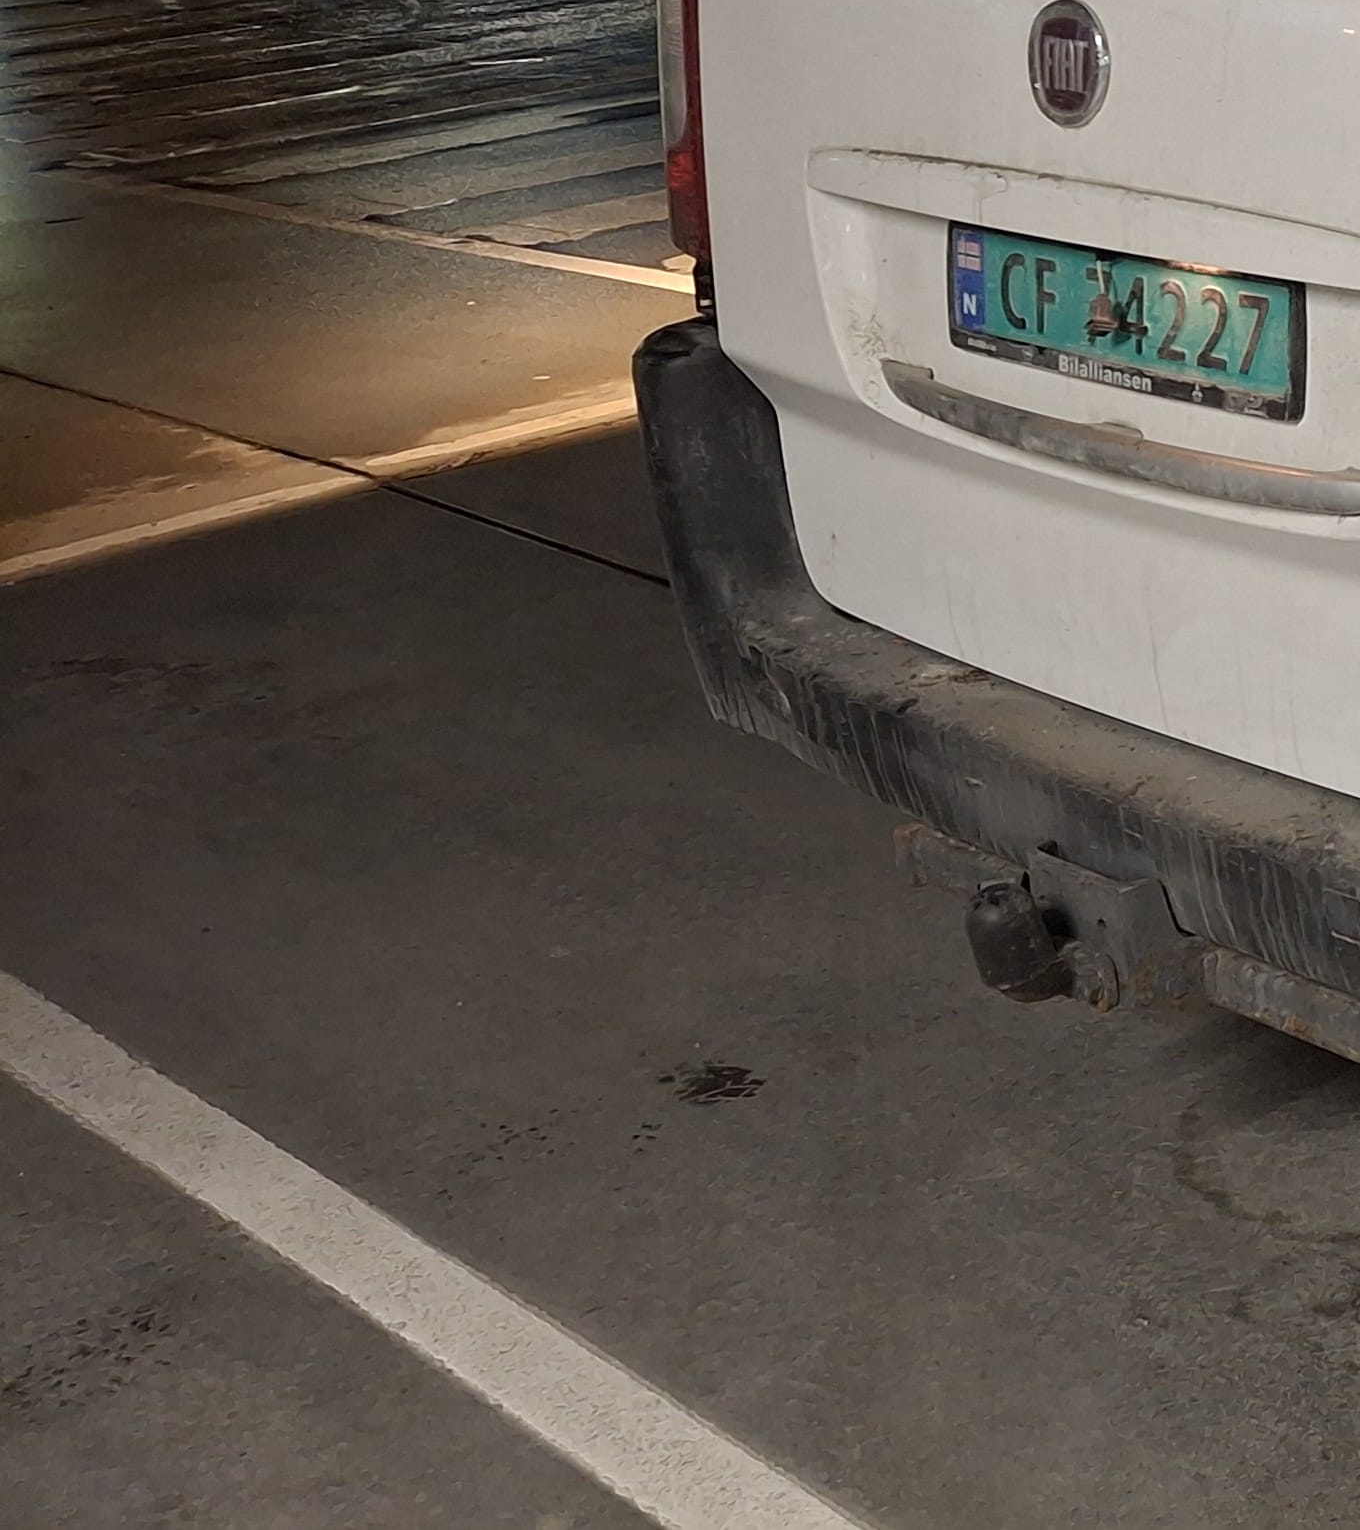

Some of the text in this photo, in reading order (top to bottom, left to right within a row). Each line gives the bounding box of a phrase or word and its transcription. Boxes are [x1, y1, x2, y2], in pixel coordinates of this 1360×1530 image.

[1041, 35, 1088, 91] FIAT
[963, 293, 978, 316] N
[1001, 253, 1057, 334] CF
[1058, 354, 1152, 392] Bilalliansen
